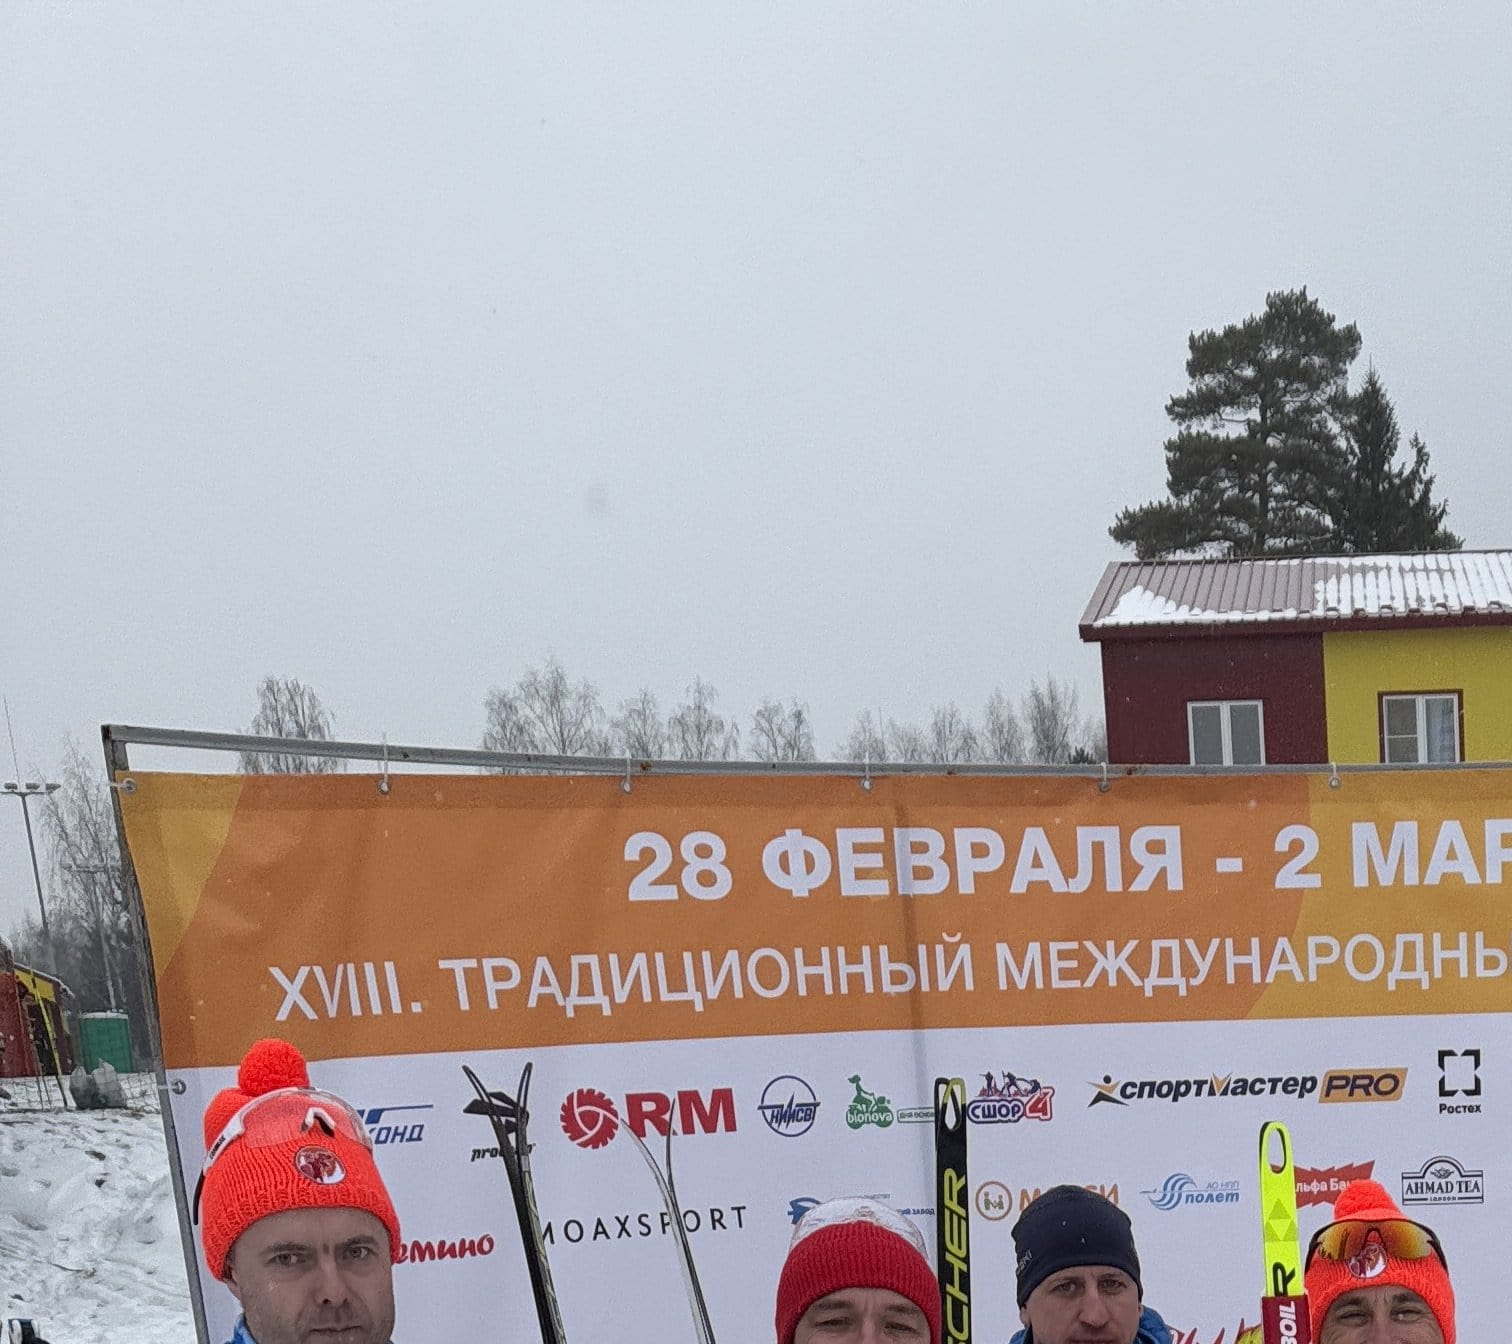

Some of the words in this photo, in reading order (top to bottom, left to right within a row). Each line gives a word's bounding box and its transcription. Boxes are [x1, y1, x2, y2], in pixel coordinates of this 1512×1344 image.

[623, 831, 733, 901] 28
[762, 825, 1184, 898] ФЕВРАЛЯ
[1216, 856, 1243, 873] -
[1274, 825, 1322, 889] 2
[268, 961, 422, 1022] XVIII.
[438, 933, 975, 1018] ТРАДИЦИОННЫЙ
[1325, 1073, 1401, 1098] PRO
[970, 1102, 1022, 1121] СШОР
[1439, 1103, 1482, 1114] Ростех
[1296, 1179, 1328, 1194] льфа
[1405, 1181, 1454, 1196] AHMAD
[1455, 1180, 1481, 1194] TEA
[1186, 1190, 1241, 1205] полет
[398, 1234, 495, 1265] емино
